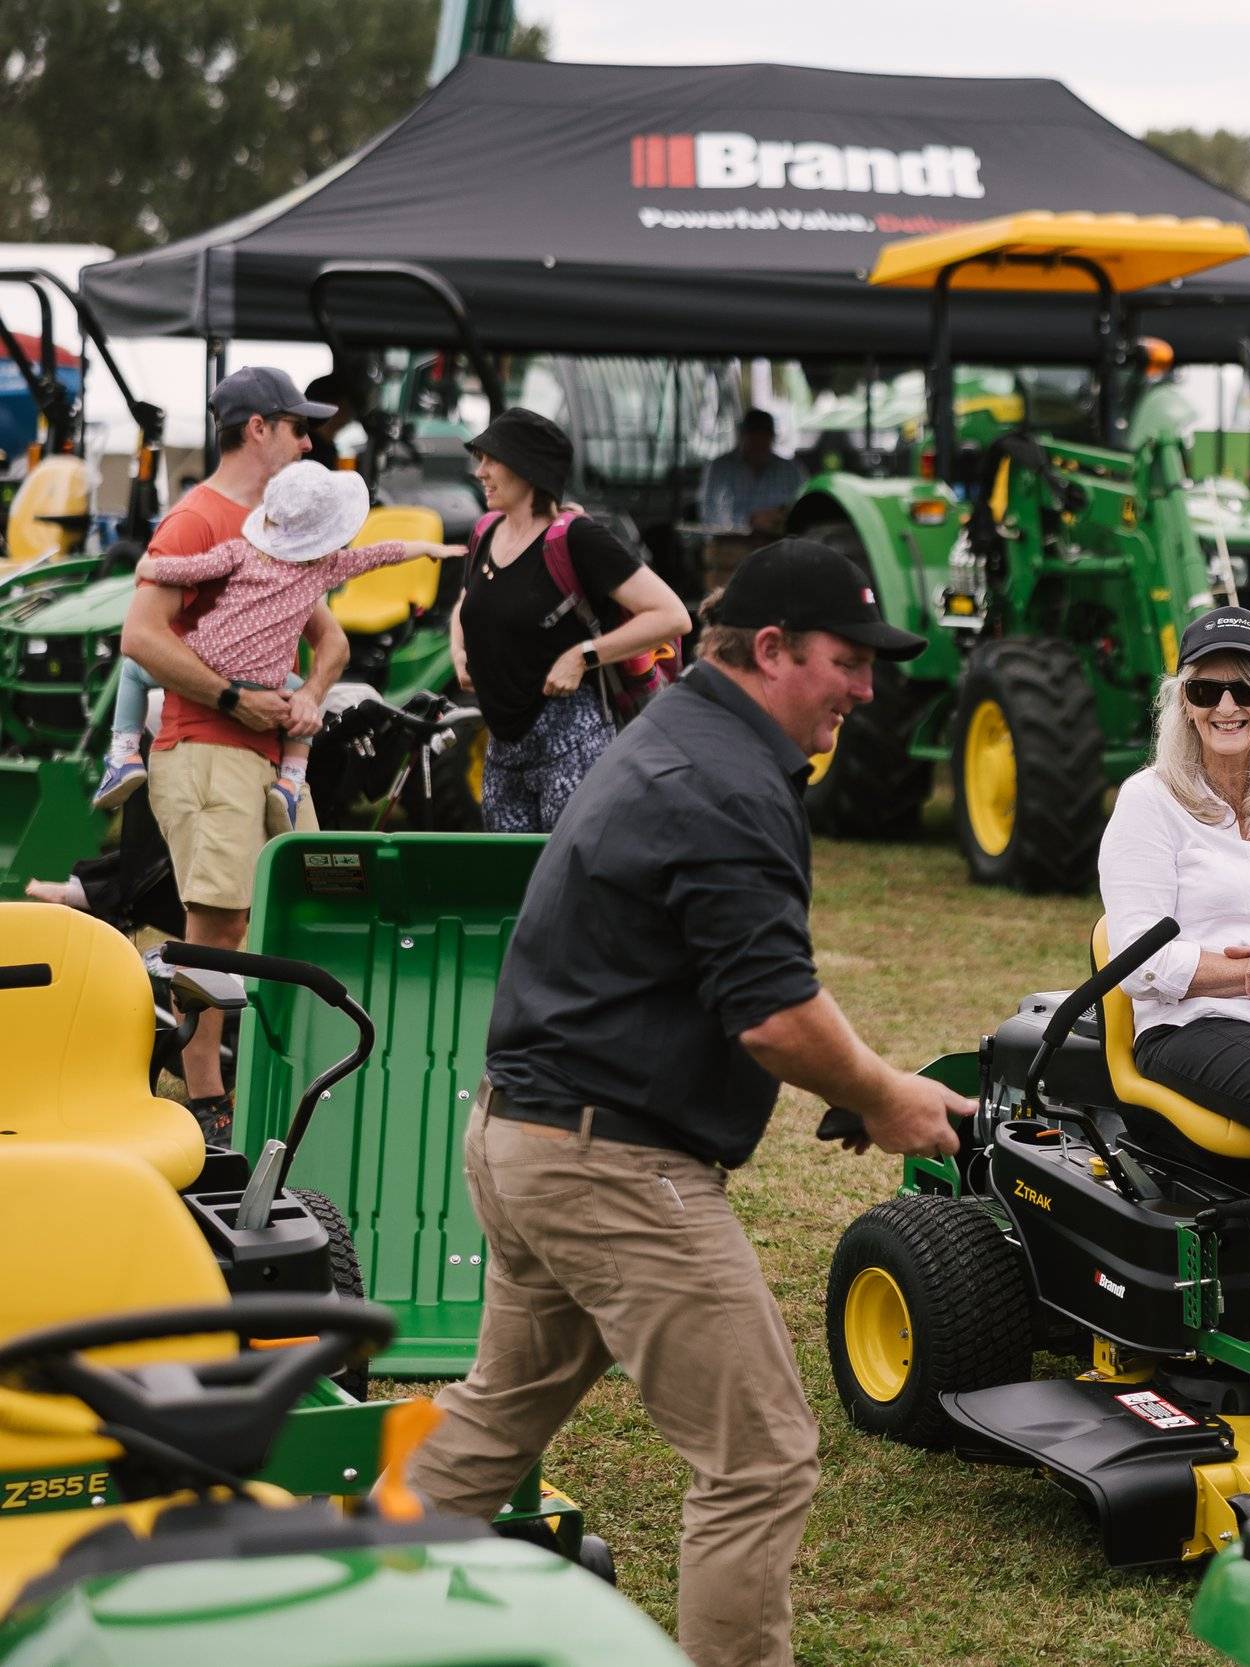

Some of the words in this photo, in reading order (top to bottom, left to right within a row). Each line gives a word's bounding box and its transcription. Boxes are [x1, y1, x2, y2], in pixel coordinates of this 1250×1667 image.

[695, 131, 986, 199] Brandt
[638, 206, 778, 230] Powerful
[1014, 1179, 1052, 1211] ZTRAK
[1099, 1273, 1125, 1298] Brandt
